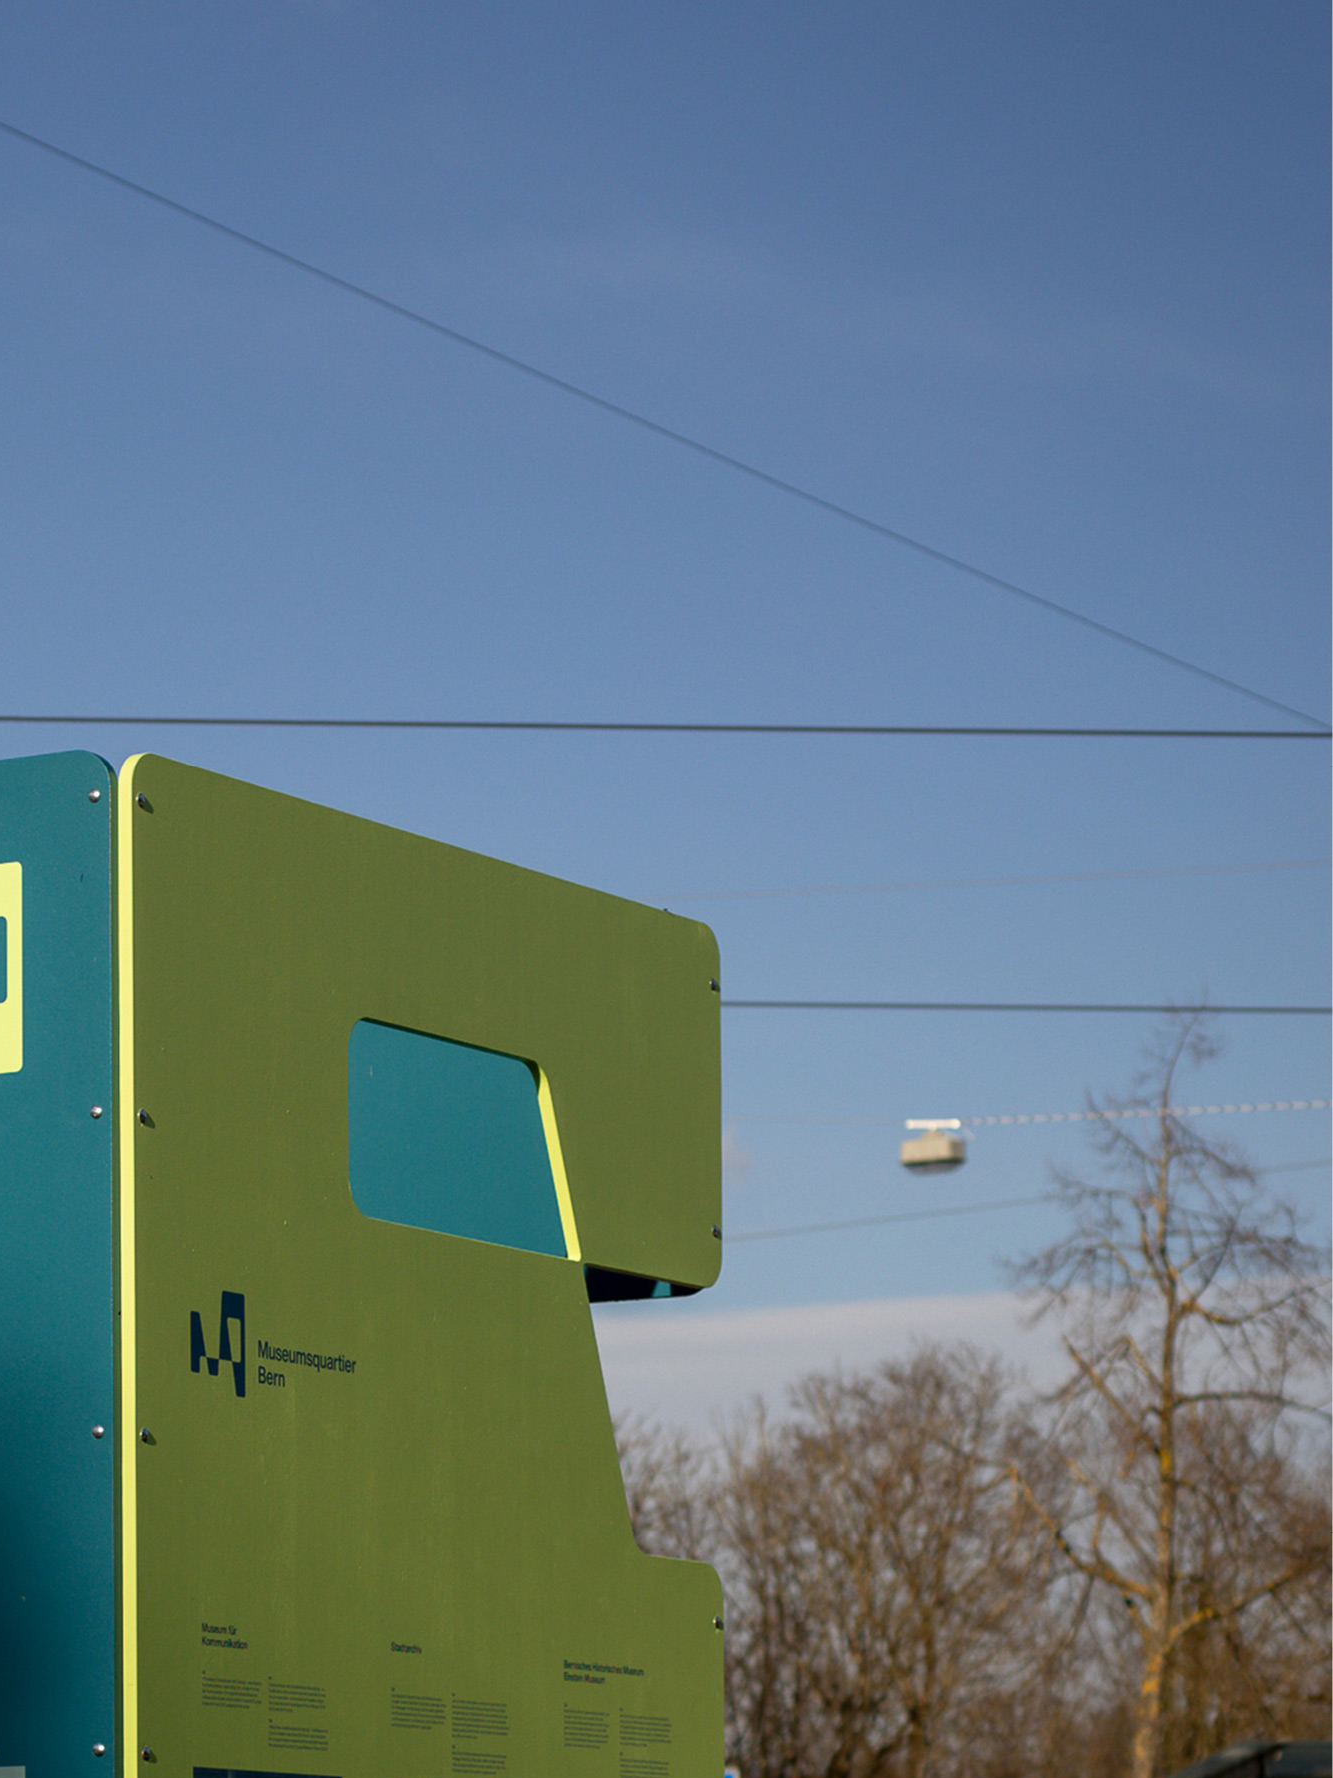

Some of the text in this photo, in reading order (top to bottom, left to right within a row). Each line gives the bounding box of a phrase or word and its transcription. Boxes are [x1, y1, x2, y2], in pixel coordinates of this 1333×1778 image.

[258, 1340, 356, 1374] Museumsquartier
[258, 1366, 285, 1388] Bern
[202, 1636, 248, 1649] Kommunikation
[623, 1665, 644, 1676] Museum
